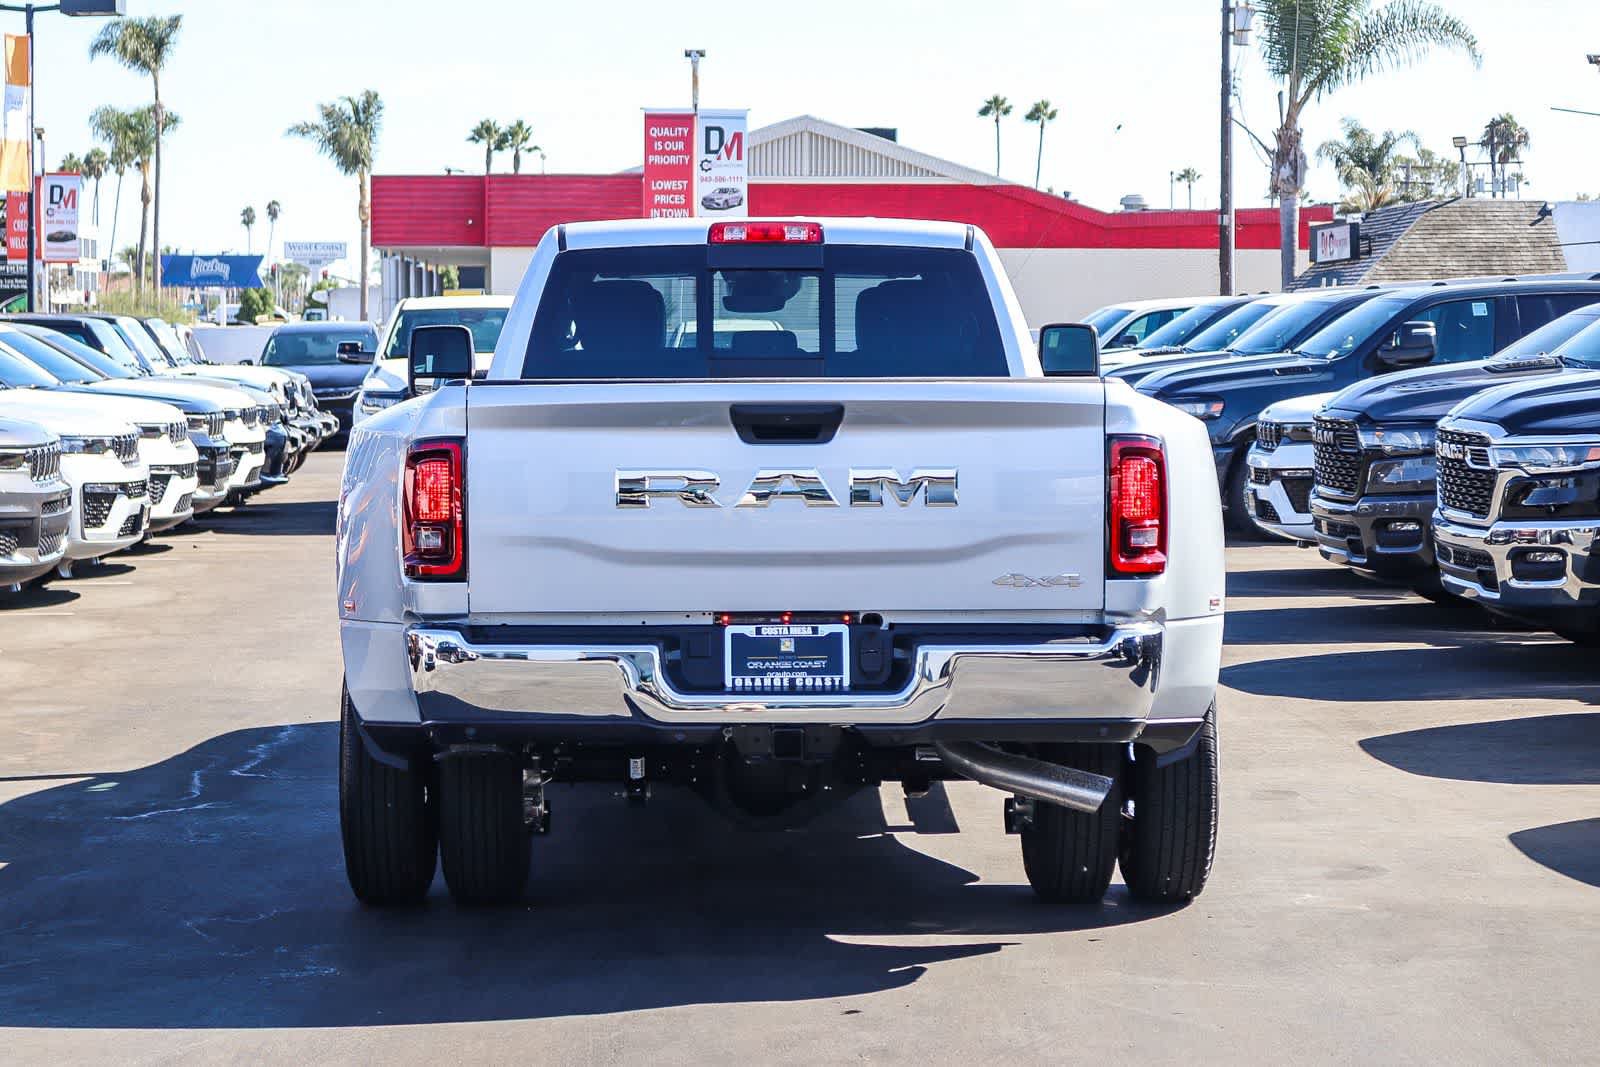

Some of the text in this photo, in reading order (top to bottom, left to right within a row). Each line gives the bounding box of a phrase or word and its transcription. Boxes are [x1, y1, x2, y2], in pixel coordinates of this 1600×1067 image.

[650, 127, 689, 137] QUALITY
[654, 141, 685, 151] IS OUR
[648, 155, 690, 165] PRIORITY
[651, 180, 688, 191] LOWEST
[654, 194, 686, 205] PRICES
[650, 208, 689, 218] IN TOWN
[13, 219, 28, 232] CRED
[615, 466, 959, 508] RAM
[761, 626, 813, 635] COSTA MESA
[746, 660, 828, 669] ORANGE COAST
[734, 677, 841, 687] ORANGE COAST
